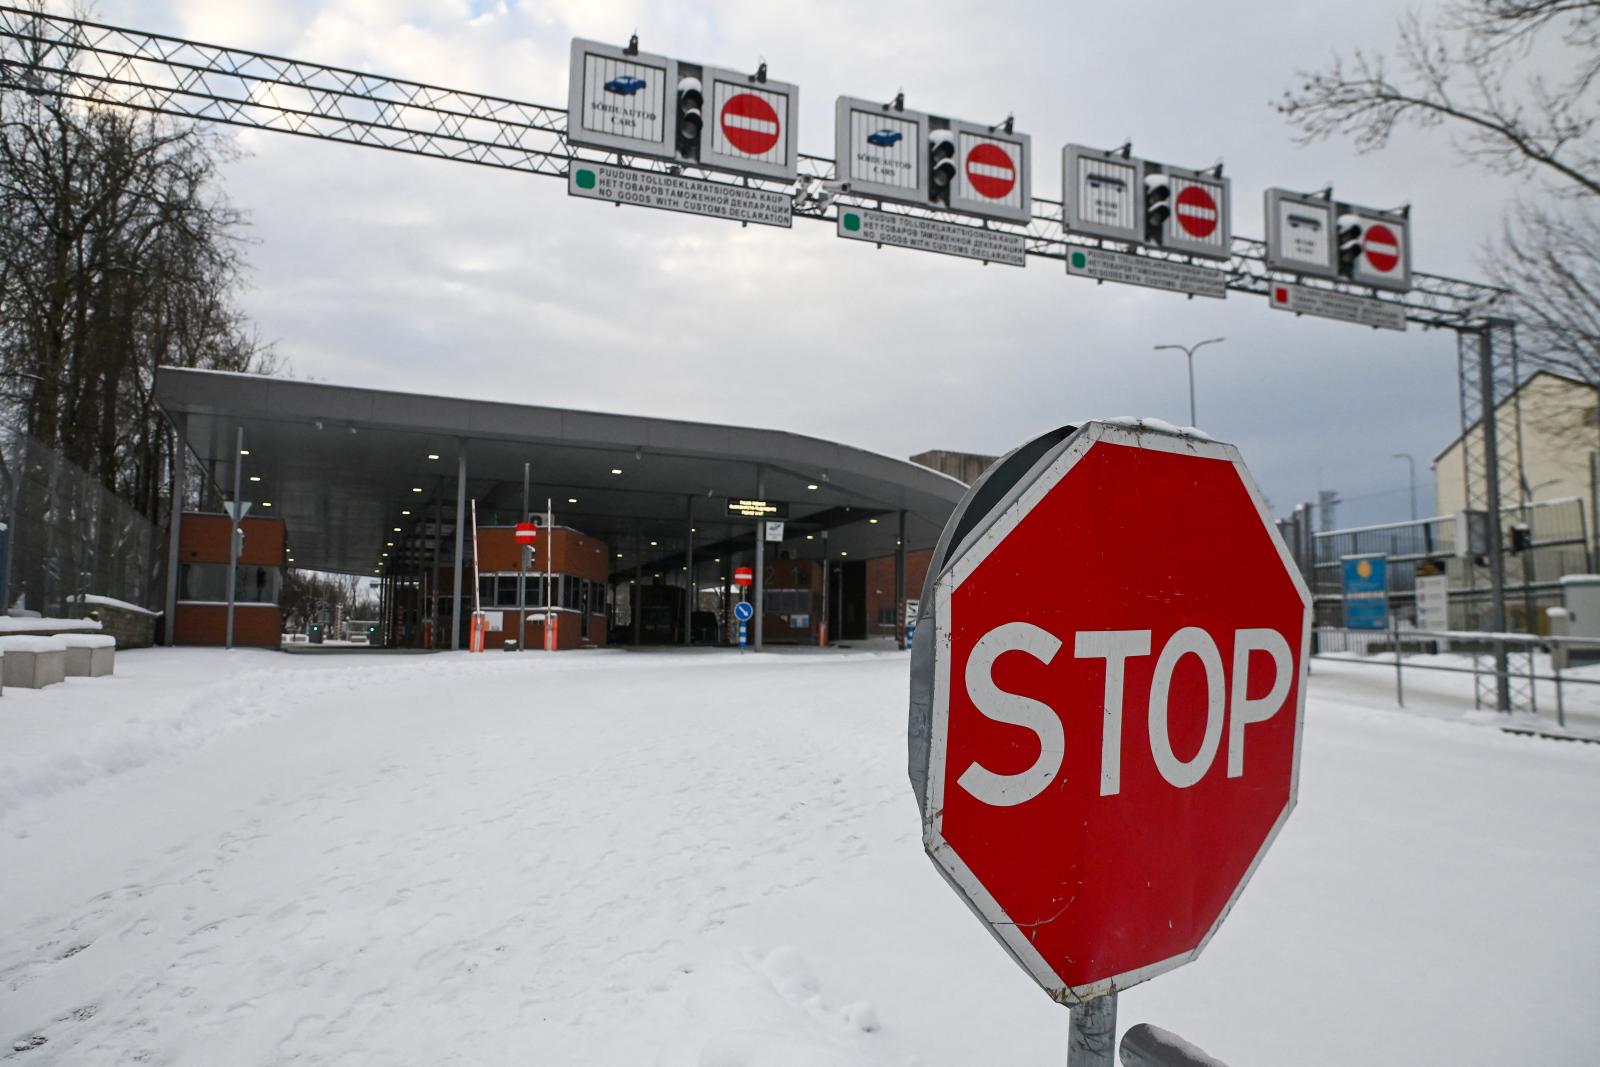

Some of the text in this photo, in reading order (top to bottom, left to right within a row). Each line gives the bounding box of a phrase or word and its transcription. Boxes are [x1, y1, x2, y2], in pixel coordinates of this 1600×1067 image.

[611, 116, 636, 127] CARS
[599, 167, 783, 203] PUUDUB TOLLIDEKLARATSIOONIGA KAUP
[599, 188, 790, 224] NO GOODS WITH CUSTOMS DECLARATION
[863, 231, 875, 239] NO
[880, 233, 908, 244] GOODS
[956, 621, 1294, 807] STOP
